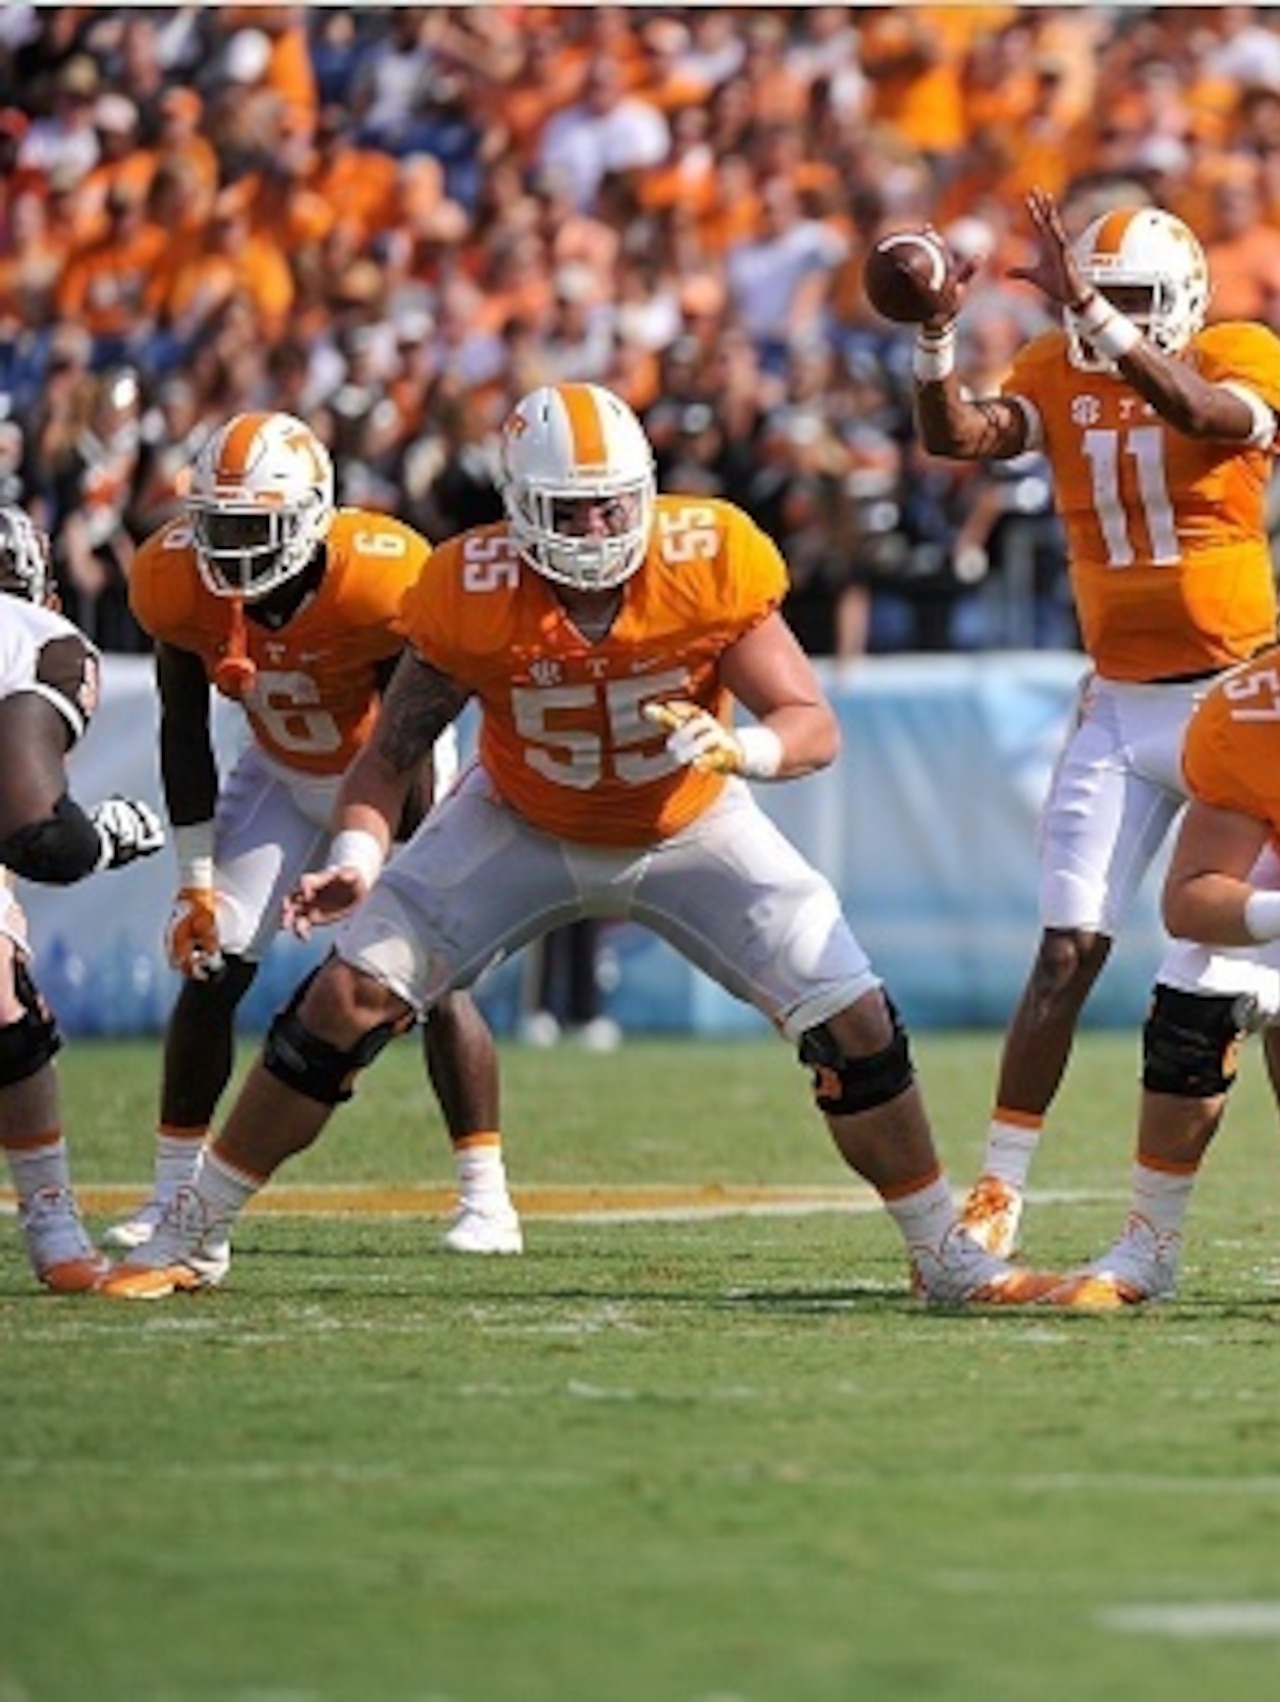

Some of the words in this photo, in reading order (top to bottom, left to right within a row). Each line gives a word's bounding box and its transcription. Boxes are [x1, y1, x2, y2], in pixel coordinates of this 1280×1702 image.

[1081, 425, 1183, 567] 11
[352, 531, 406, 558] 6
[463, 536, 520, 593] 55
[658, 507, 719, 564] 55
[245, 669, 342, 754] 6
[511, 664, 692, 791] 55
